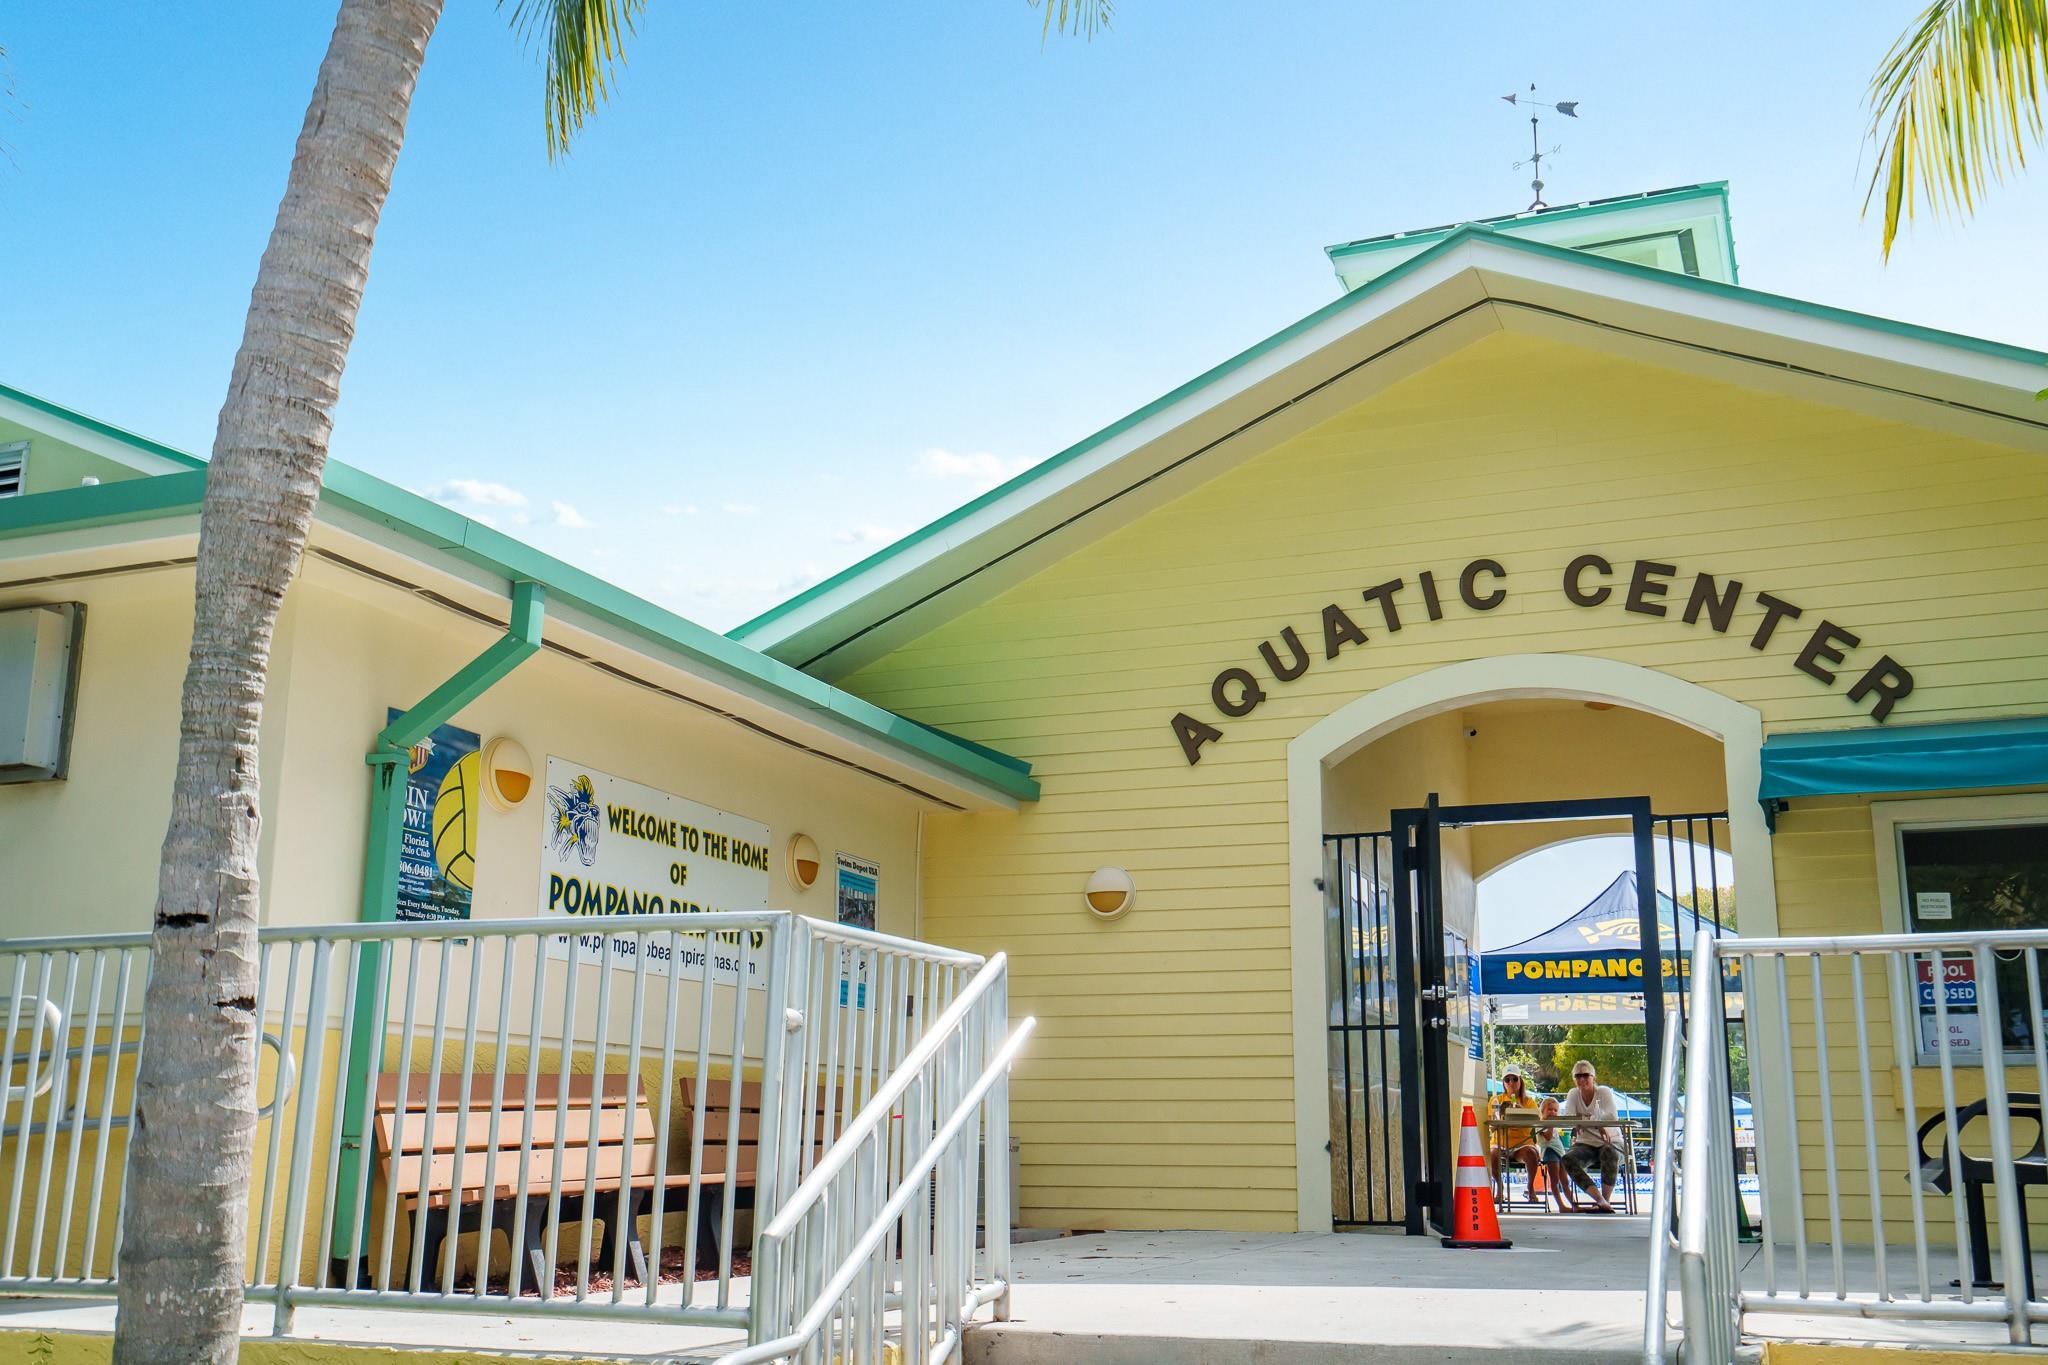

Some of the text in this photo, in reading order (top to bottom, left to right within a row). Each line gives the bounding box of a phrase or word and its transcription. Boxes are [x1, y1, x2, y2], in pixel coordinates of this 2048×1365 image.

[1170, 554, 1914, 766] AQUATIC CENTER
[405, 785, 429, 810] IN
[404, 833, 430, 848] Florida
[607, 803, 769, 872] WELCOME TO THE HOME
[402, 844, 431, 858] Polo Club
[670, 863, 687, 886] OF
[1506, 958, 1643, 980] POMPANO
